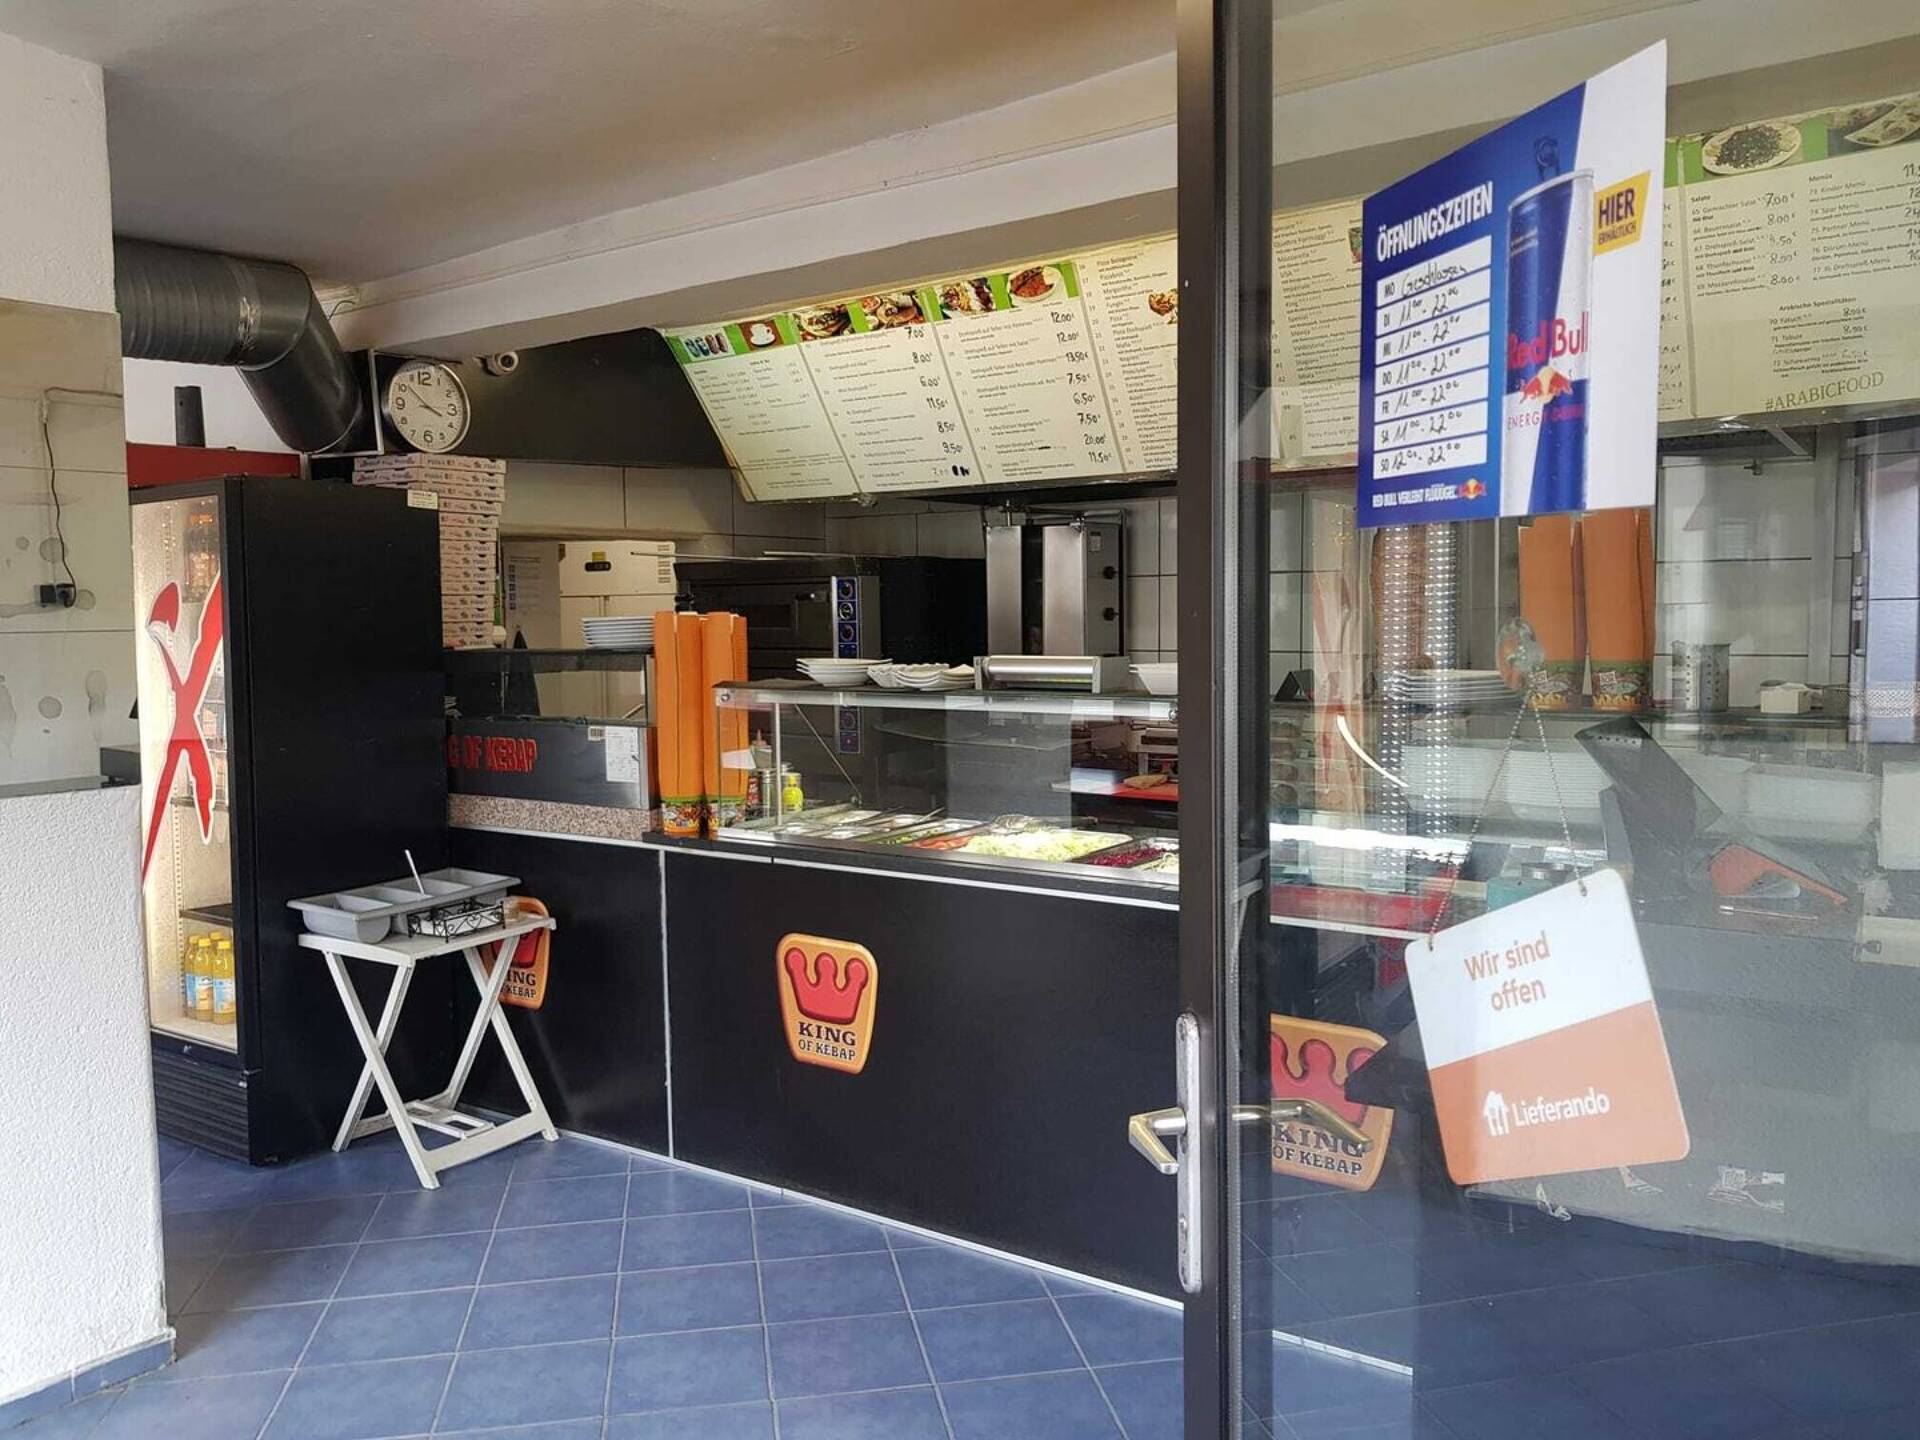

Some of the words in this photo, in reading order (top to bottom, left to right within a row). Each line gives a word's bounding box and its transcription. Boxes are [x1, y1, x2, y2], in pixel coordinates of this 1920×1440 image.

[1599, 188, 1635, 229] HIER
[1377, 180, 1493, 262] ÖFFNUNGSZEITEN
[1384, 281, 1395, 298] MO
[1779, 303, 1812, 311] Arabische
[1508, 319, 1548, 371] Red
[1551, 311, 1589, 359] Bull
[417, 371, 432, 387] 12
[1382, 371, 1392, 386] DO
[395, 397, 406, 410] 9
[1765, 371, 1884, 412] #ARABICFOOD
[447, 403, 457, 416] 3
[423, 430, 434, 443] 6
[1380, 458, 1389, 472] SO
[485, 737, 538, 773] KEBAP
[1463, 949, 1501, 982] Wir
[1505, 929, 1552, 970] sind
[507, 969, 537, 986] ING
[1491, 977, 1547, 1012] offen
[798, 1021, 857, 1047] KING
[798, 1038, 813, 1052] OF
[815, 1042, 856, 1061] KEBAP
[1512, 1087, 1611, 1127] Lieferando
[1272, 1145, 1297, 1162] OF
[1299, 1151, 1363, 1176] KEBAP
